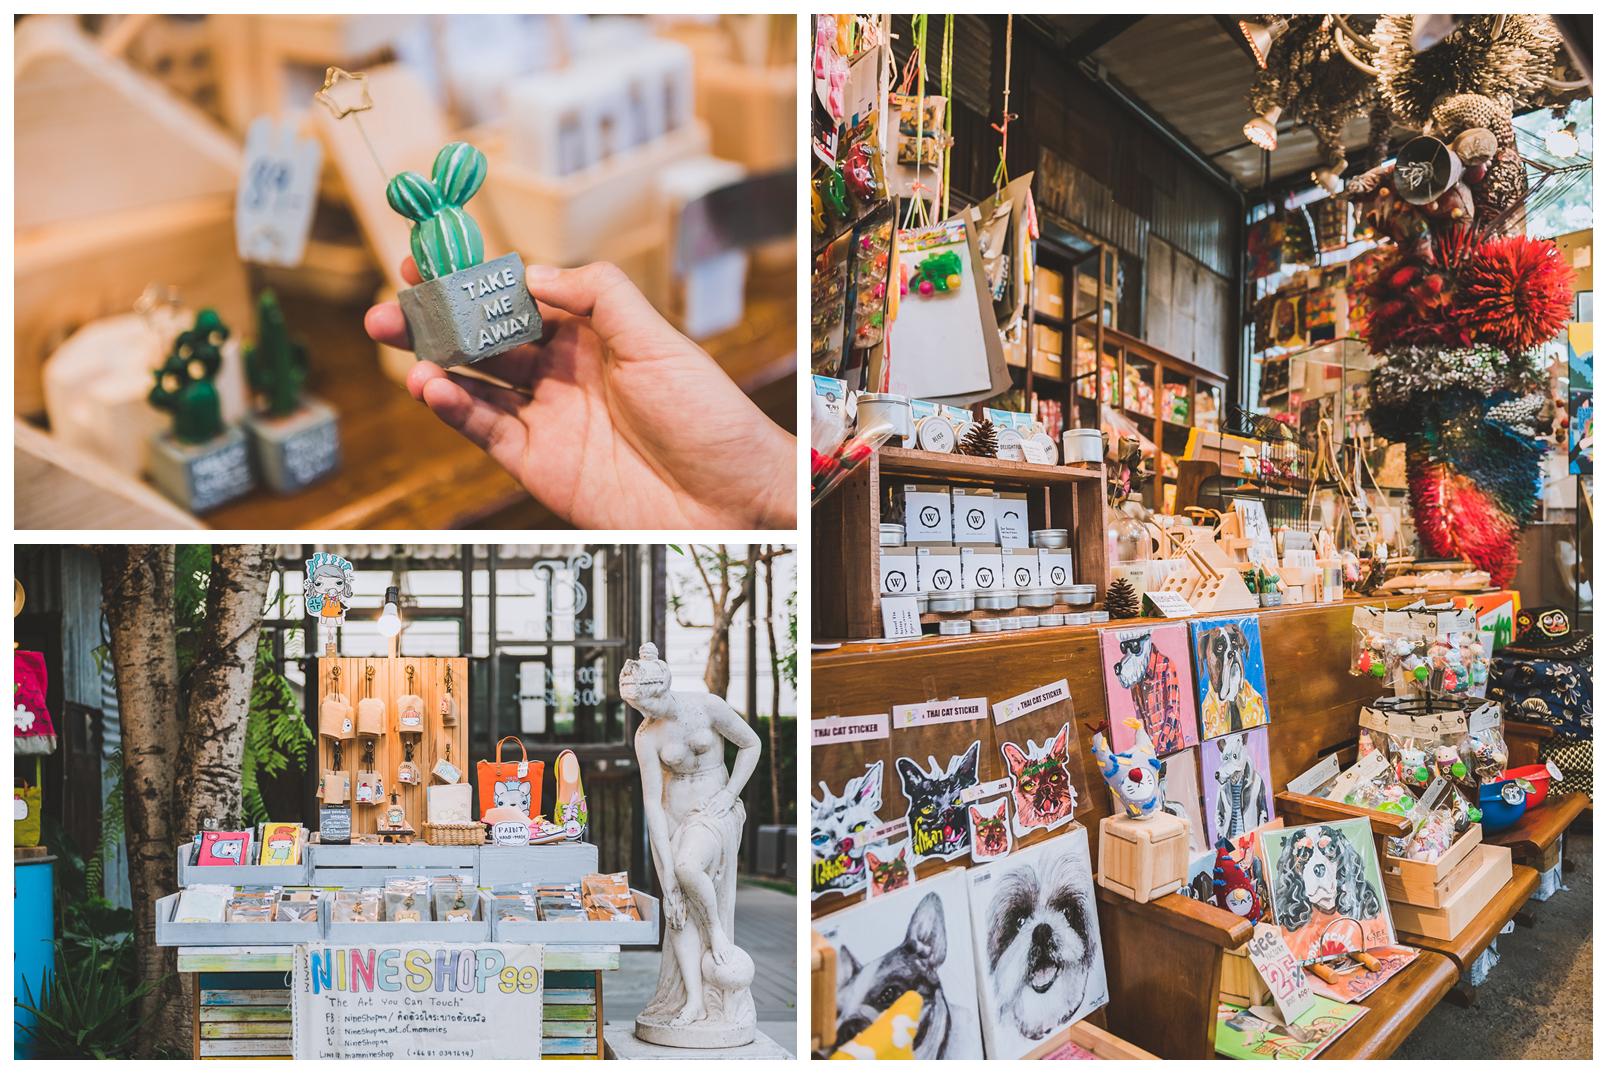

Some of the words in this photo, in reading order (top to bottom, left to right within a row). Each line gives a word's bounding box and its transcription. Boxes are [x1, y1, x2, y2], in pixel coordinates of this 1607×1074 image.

[462, 268, 516, 301] TAKE
[483, 296, 513, 321] ME
[478, 313, 531, 350] AWAY
[932, 432, 944, 443] BLISS
[925, 513, 936, 522] W
[971, 515, 981, 524] W
[937, 576, 948, 585] W
[980, 574, 990, 583] W
[1018, 574, 1027, 582] W
[1054, 572, 1063, 581] W
[890, 578, 902, 588] W
[1020, 701, 1032, 709] THAI
[1032, 695, 1042, 704] CAT
[1042, 688, 1063, 701] STICKER
[927, 710, 941, 718] THAI
[941, 708, 953, 717] CAT
[954, 705, 979, 715] STICKER
[814, 729, 831, 738] THAI
[833, 726, 847, 736] CAT
[848, 724, 878, 734] STICKER
[357, 997, 373, 1006] Art
[404, 997, 423, 1006] Can
[327, 1027, 335, 1035] IG
